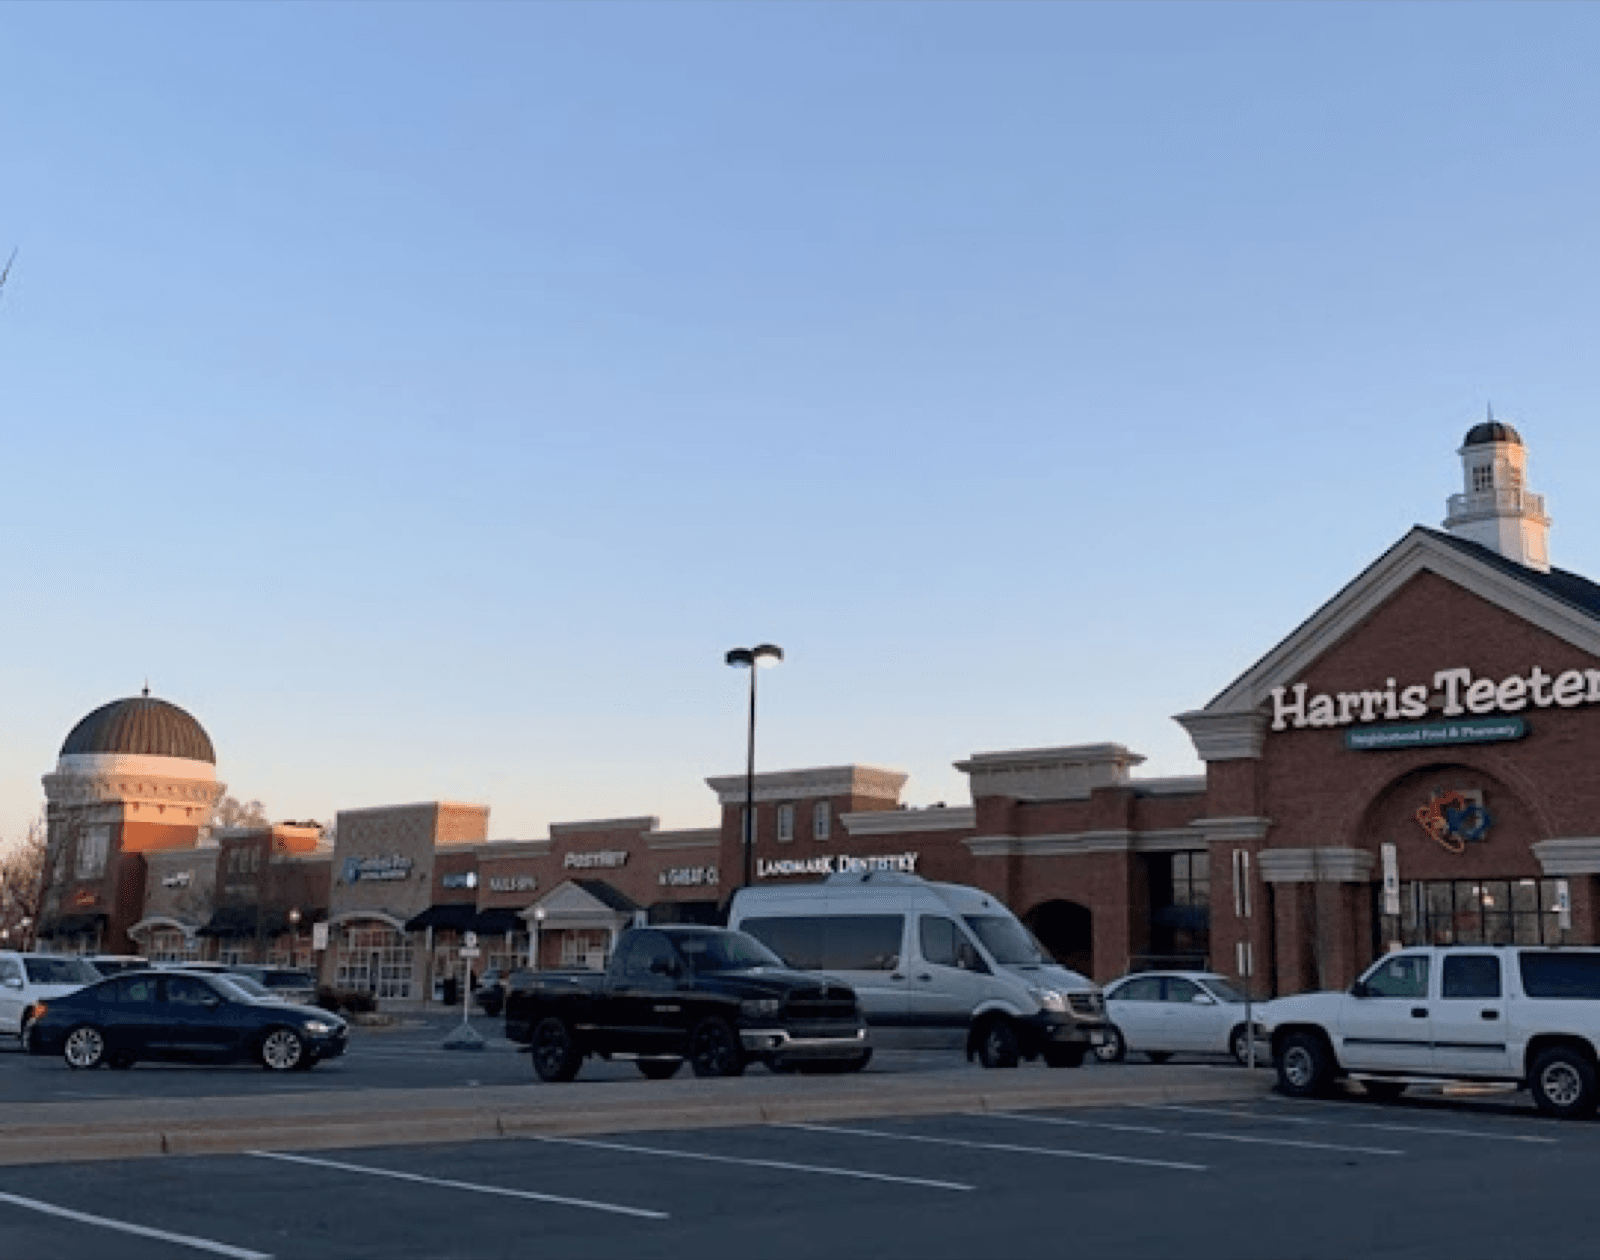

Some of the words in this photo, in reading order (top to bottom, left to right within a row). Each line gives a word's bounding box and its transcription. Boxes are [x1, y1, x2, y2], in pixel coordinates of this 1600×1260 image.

[1271, 677, 1427, 731] Harris
[1434, 665, 1600, 716] Teeter
[1449, 726, 1459, 737] &
